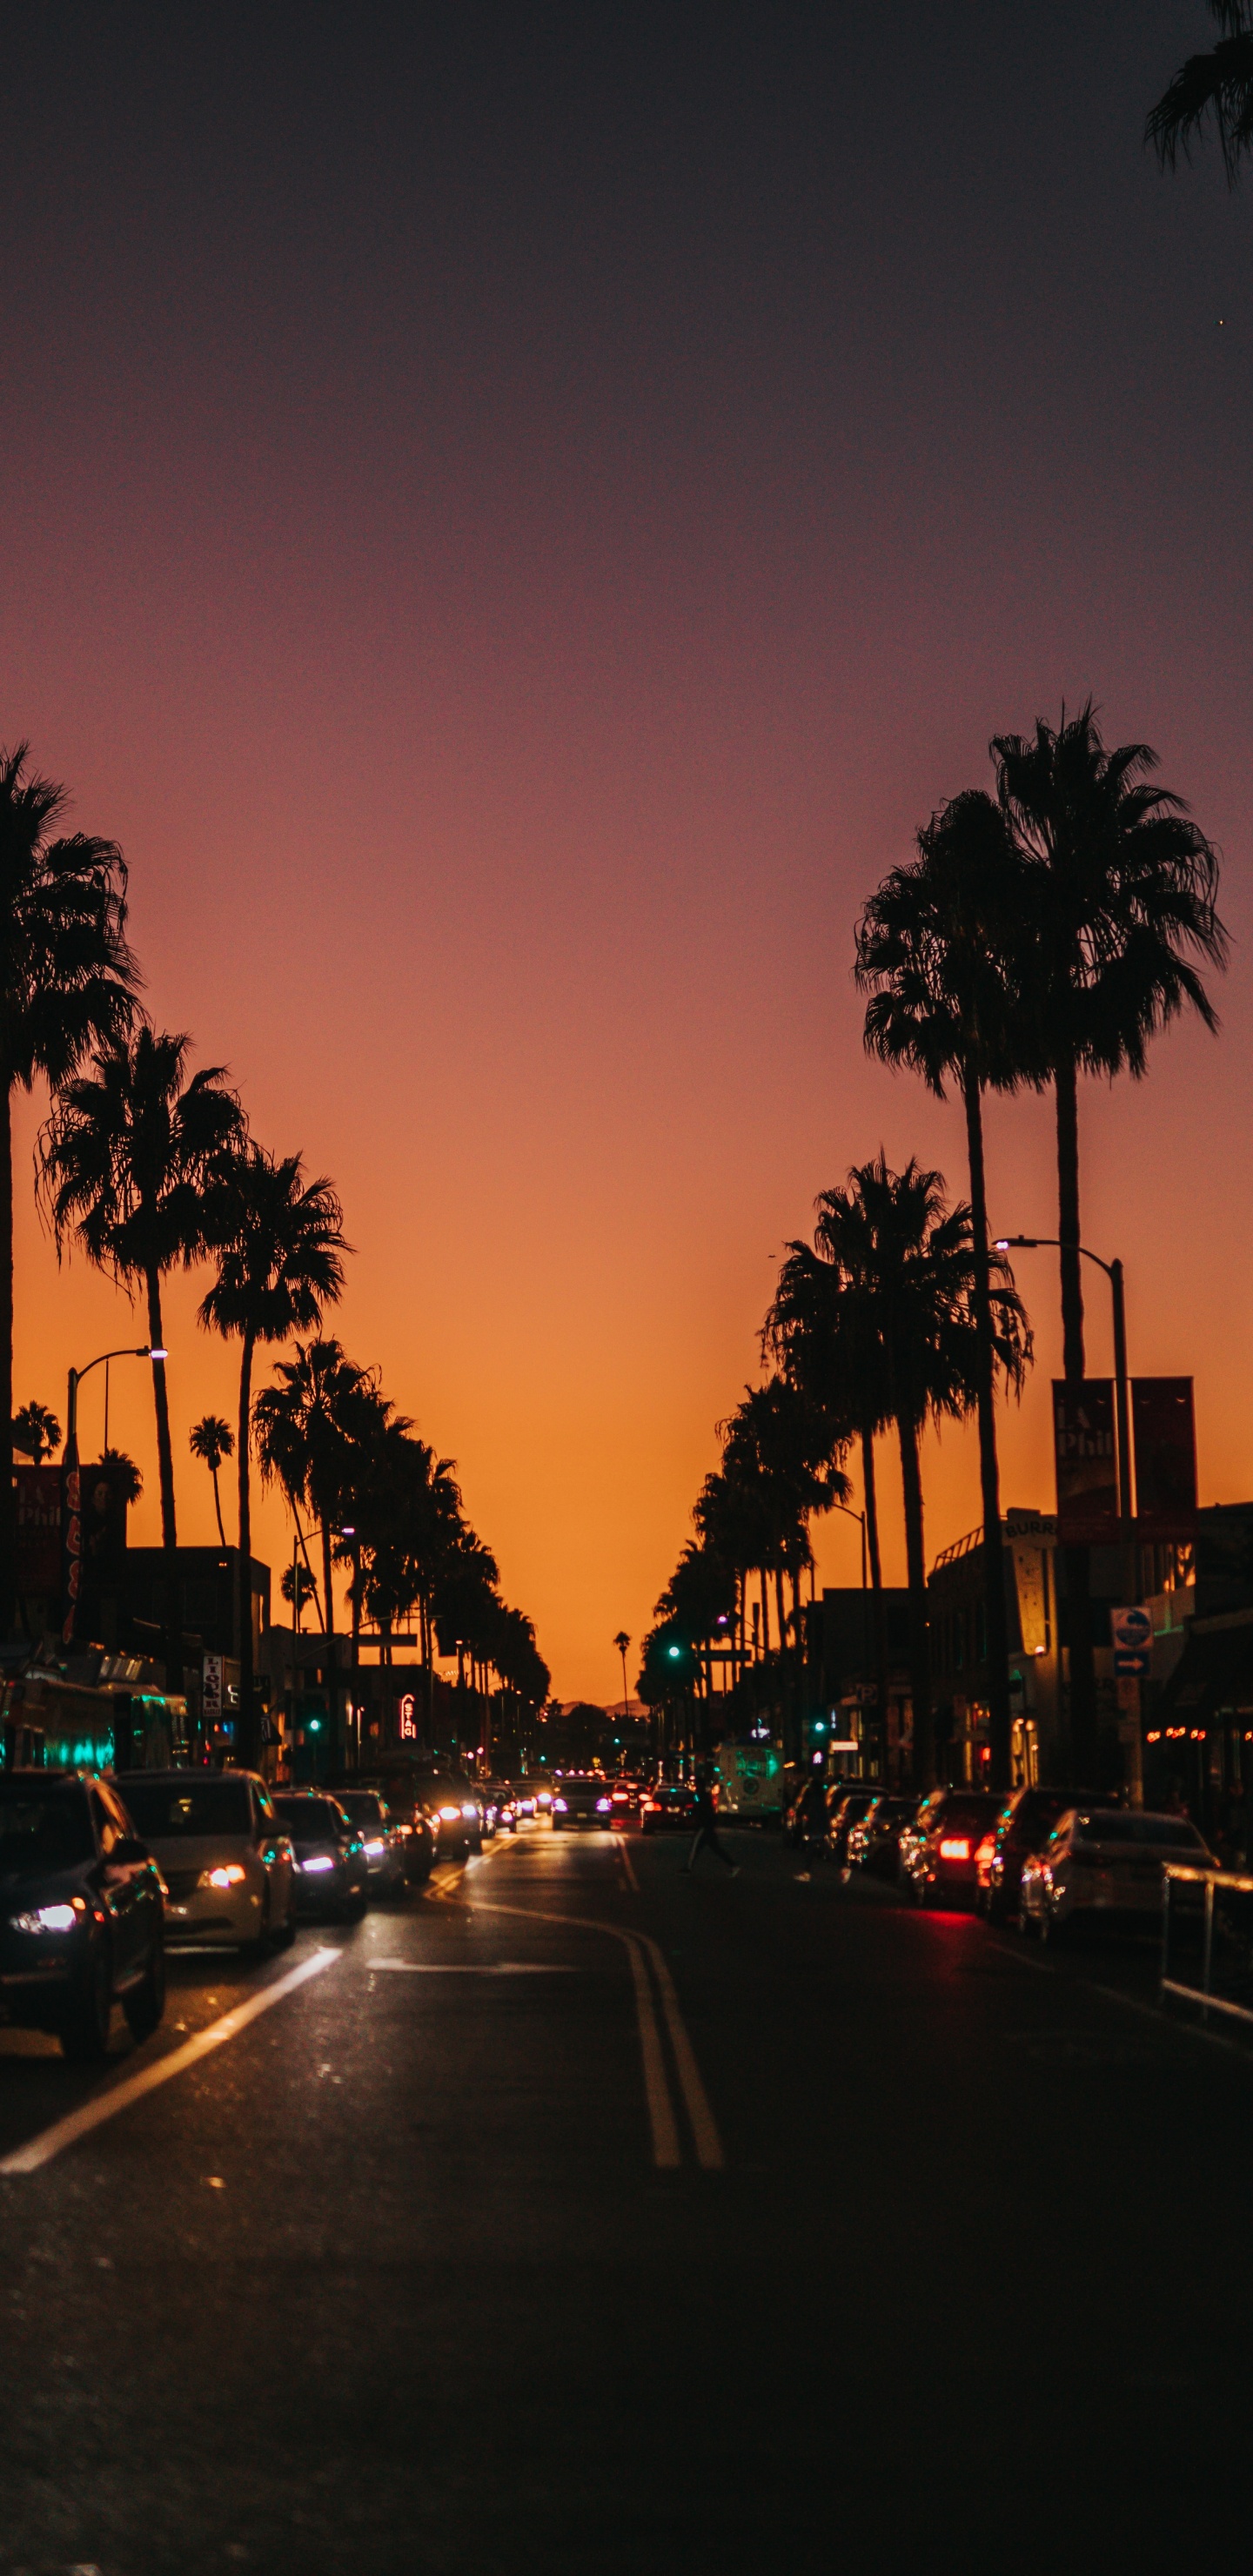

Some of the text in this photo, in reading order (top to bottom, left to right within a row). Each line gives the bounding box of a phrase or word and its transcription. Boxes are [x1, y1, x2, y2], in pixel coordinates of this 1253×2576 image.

[1058, 1430, 1112, 1457] Phil
[18, 1506, 62, 1526] Phil
[404, 1702, 413, 1737] STAG
